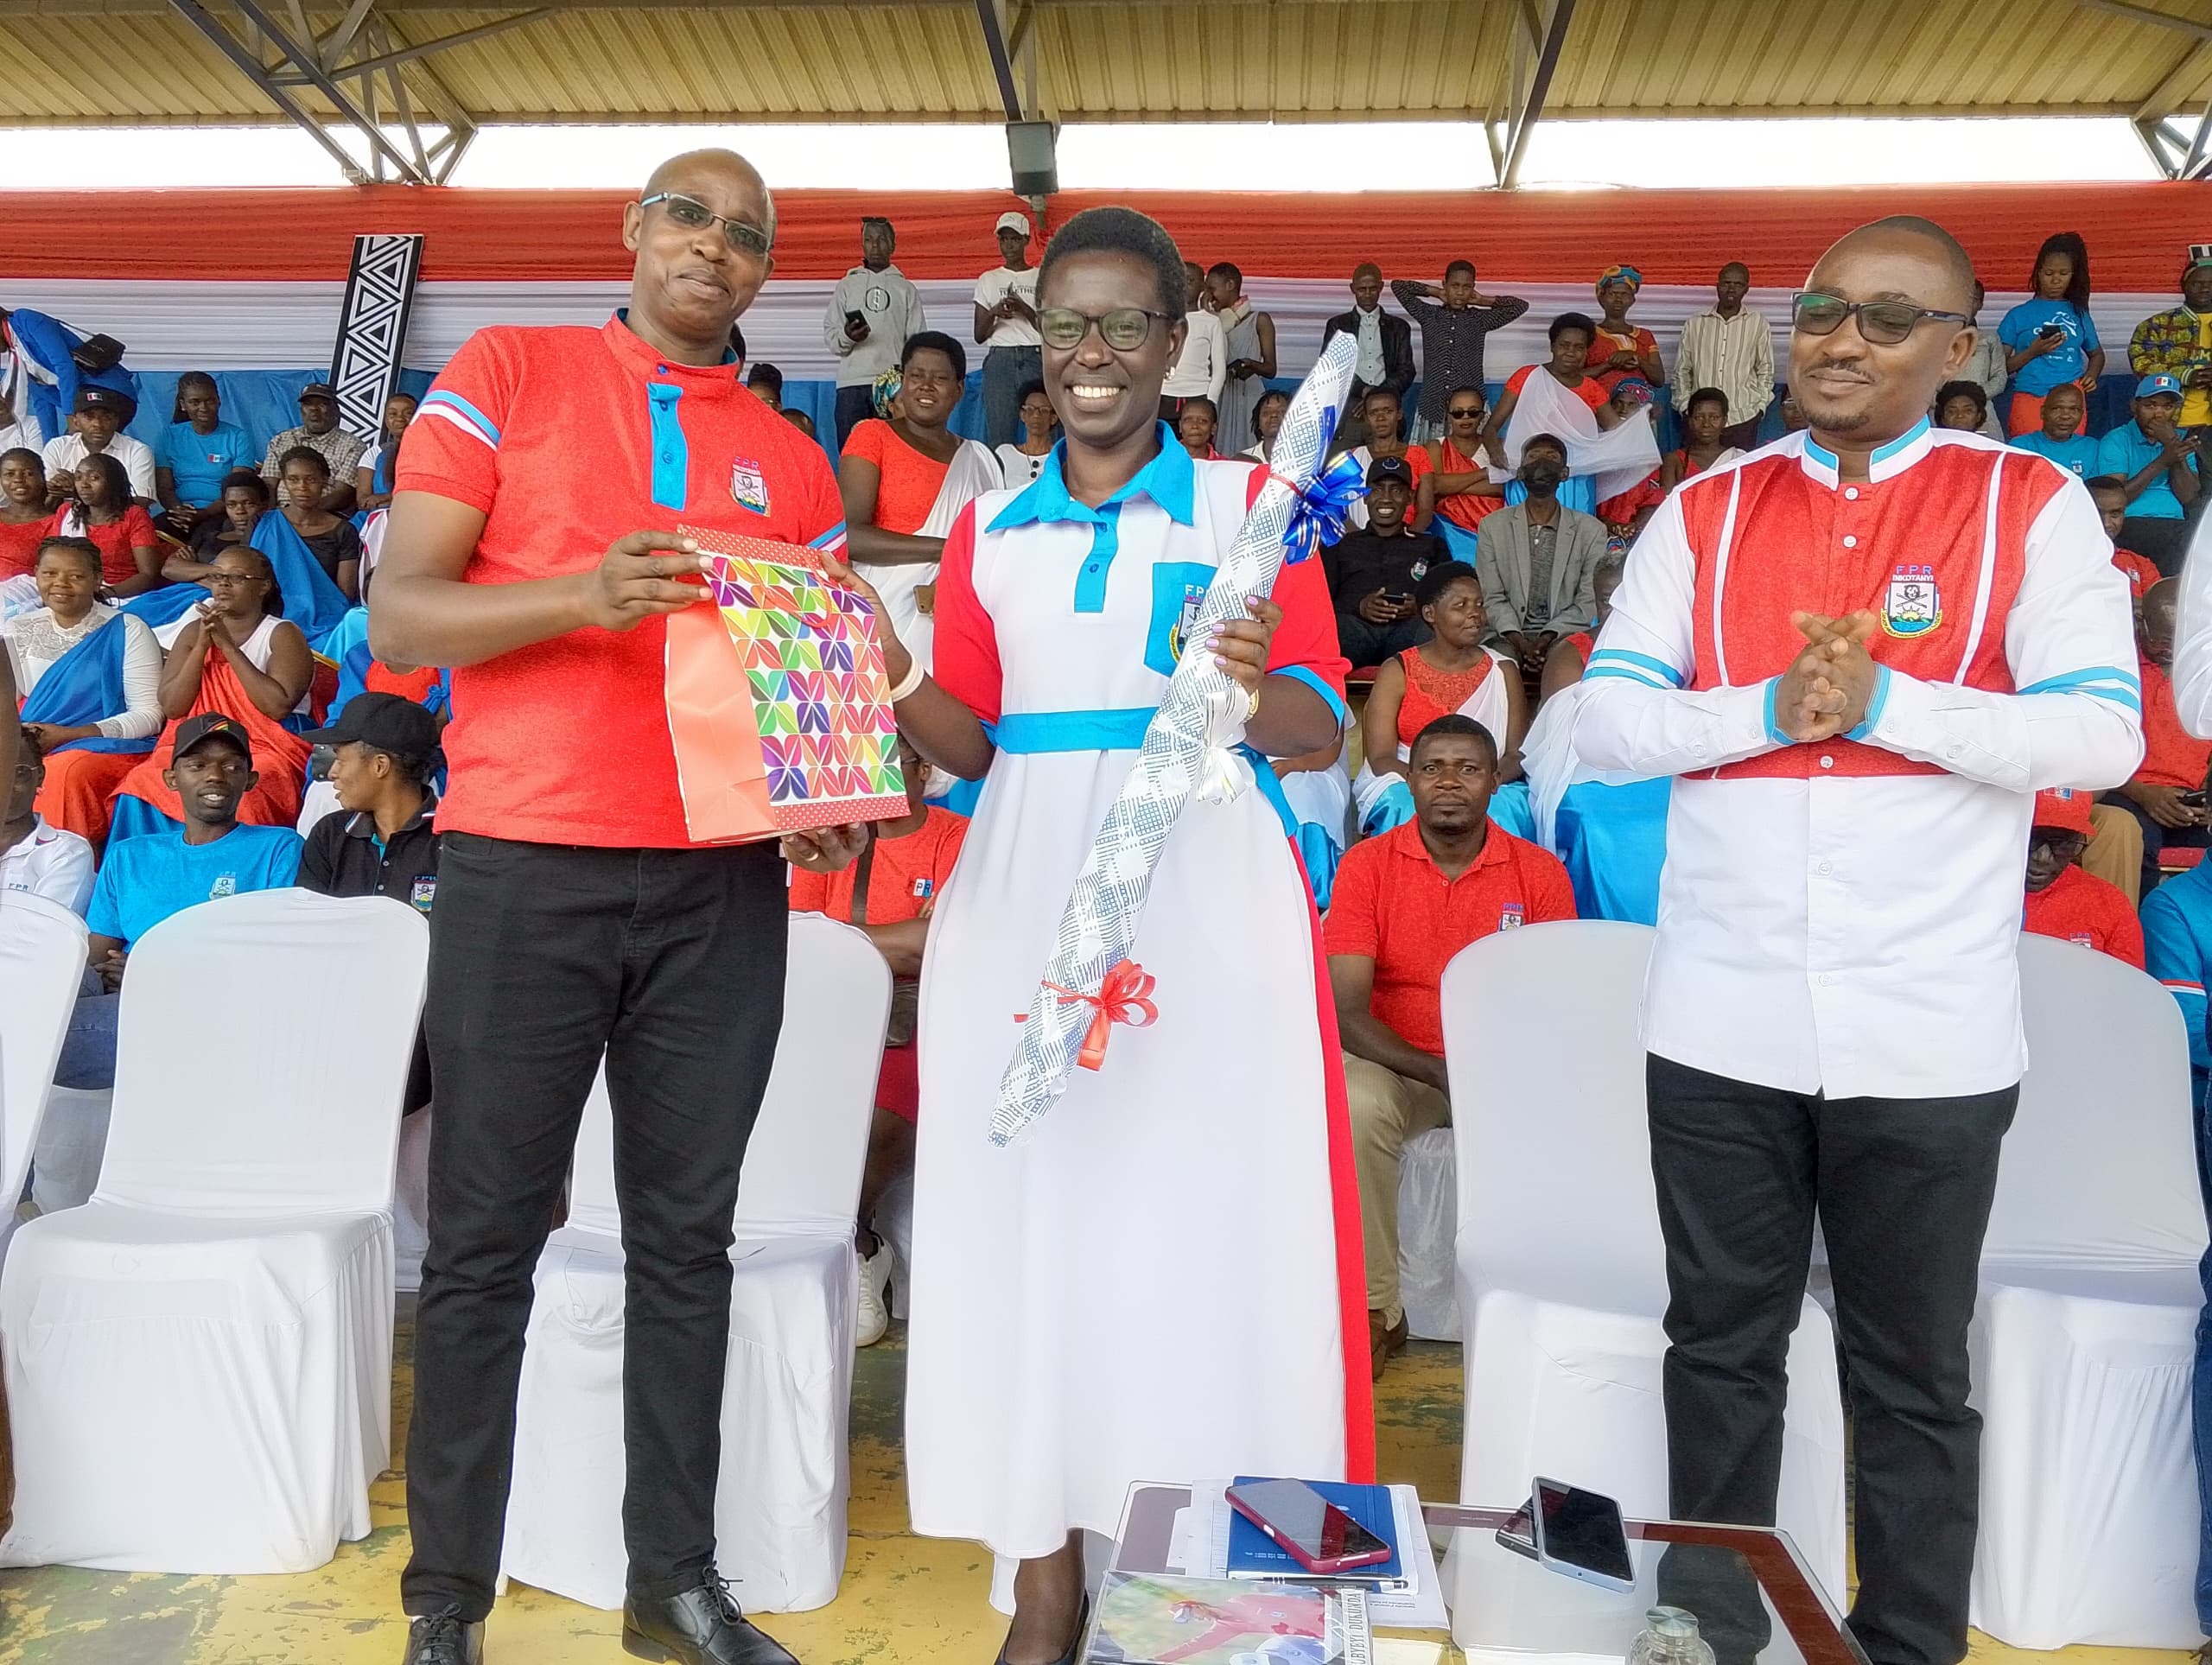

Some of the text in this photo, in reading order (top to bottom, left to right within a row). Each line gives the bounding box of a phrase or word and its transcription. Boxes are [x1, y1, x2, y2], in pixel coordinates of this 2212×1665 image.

[734, 455, 760, 470] FPR
[1896, 564, 1933, 575] FPR
[1185, 584, 1205, 597] FP
[1348, 1593, 1363, 1630] DUKUNDA
